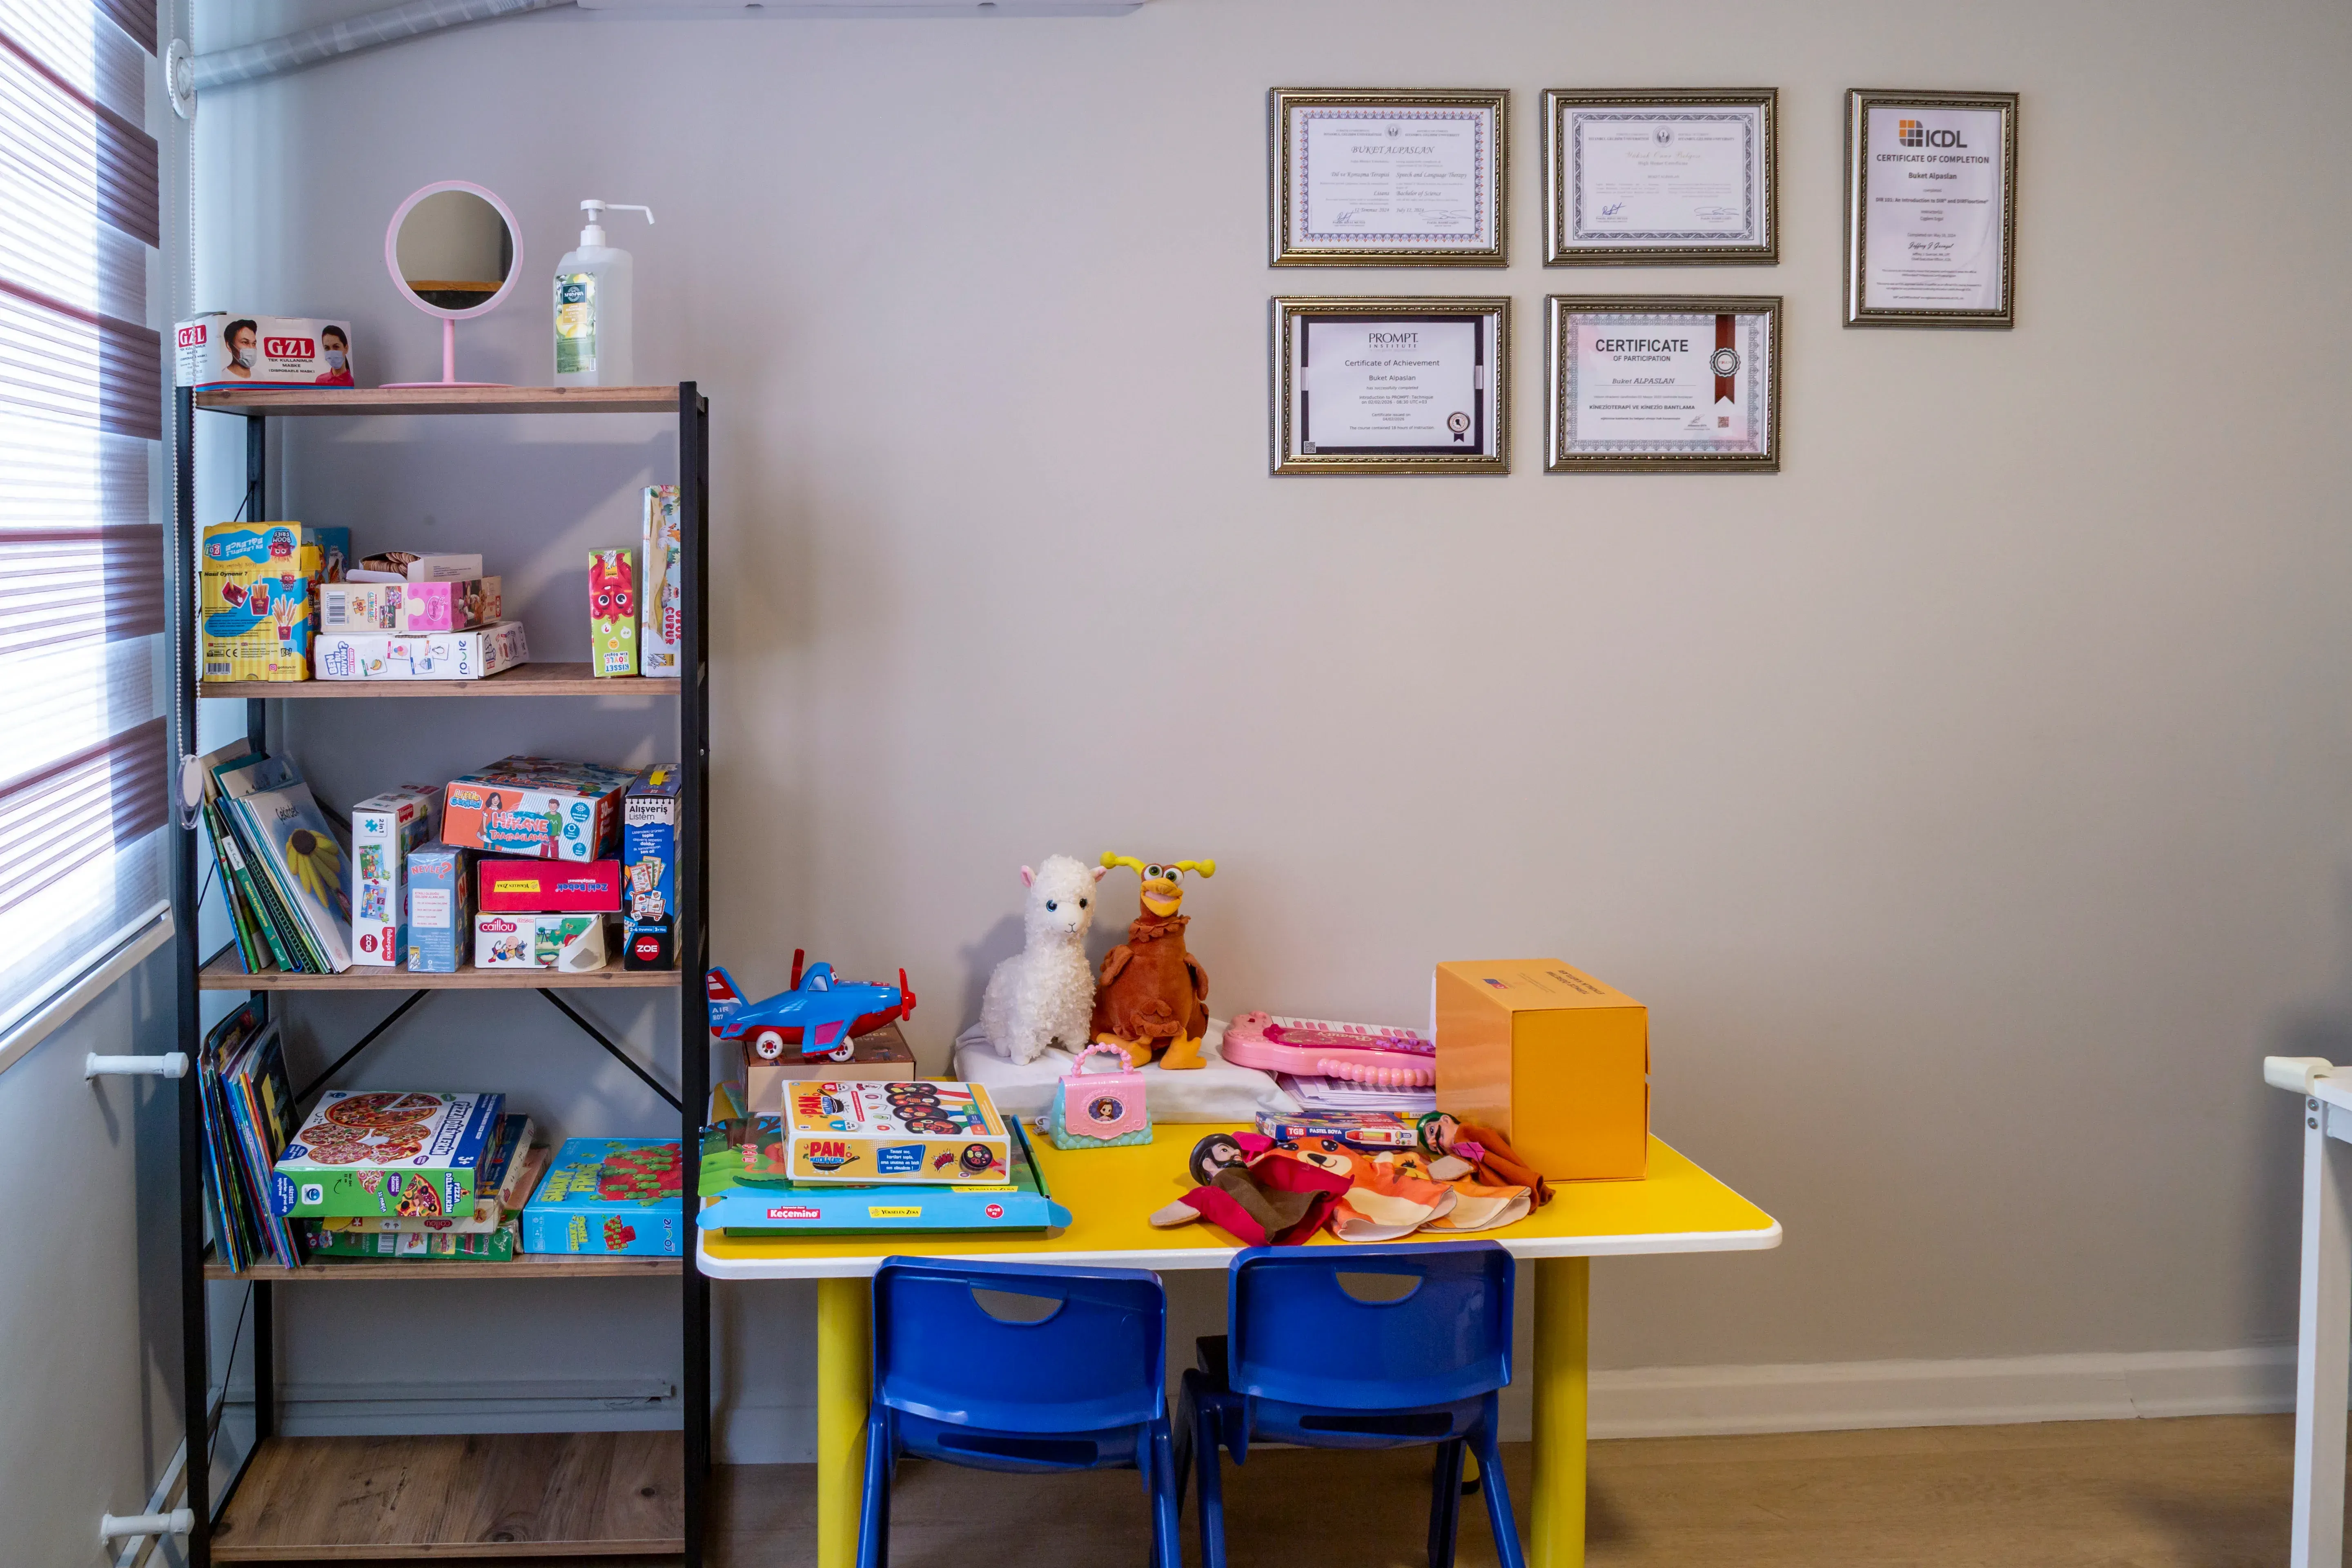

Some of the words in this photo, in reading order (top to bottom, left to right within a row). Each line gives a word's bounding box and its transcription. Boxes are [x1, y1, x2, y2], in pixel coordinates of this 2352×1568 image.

[1925, 130, 1967, 148] ICDL
[1384, 145, 1435, 155] ALPASLAN
[1876, 154, 1924, 163] CERTIFICATE
[180, 327, 205, 345] GZL
[267, 340, 312, 356] GZL
[1595, 339, 1689, 352] CERTIFICATE
[357, 602, 363, 612] 50
[281, 648, 292, 657] go!
[335, 652, 341, 662] BU
[339, 641, 348, 675] MUYUM?
[326, 655, 338, 675] BEN
[454, 789, 480, 802] Little
[449, 797, 483, 808] Genius!
[630, 805, 668, 817] Alışveriş
[492, 812, 549, 833] HİKAYE
[490, 830, 549, 842] TAMAMLAMA
[411, 862, 452, 880] NEYLE?
[557, 883, 586, 892] Bebek
[588, 883, 608, 892] Zeki
[481, 922, 514, 931] caillou
[1318, 1031, 1372, 1042] Beauty
[798, 1096, 824, 1115] PAN
[810, 1141, 845, 1158] PAN
[458, 1156, 472, 1165] 3+
[569, 1163, 604, 1192] FROG
[445, 1173, 454, 1212] DİLİMLERİM
[770, 1209, 817, 1218] Keçemino
[577, 1216, 588, 1243] FROG
[663, 1218, 673, 1252] route
[569, 1222, 579, 1251] SHAKY
